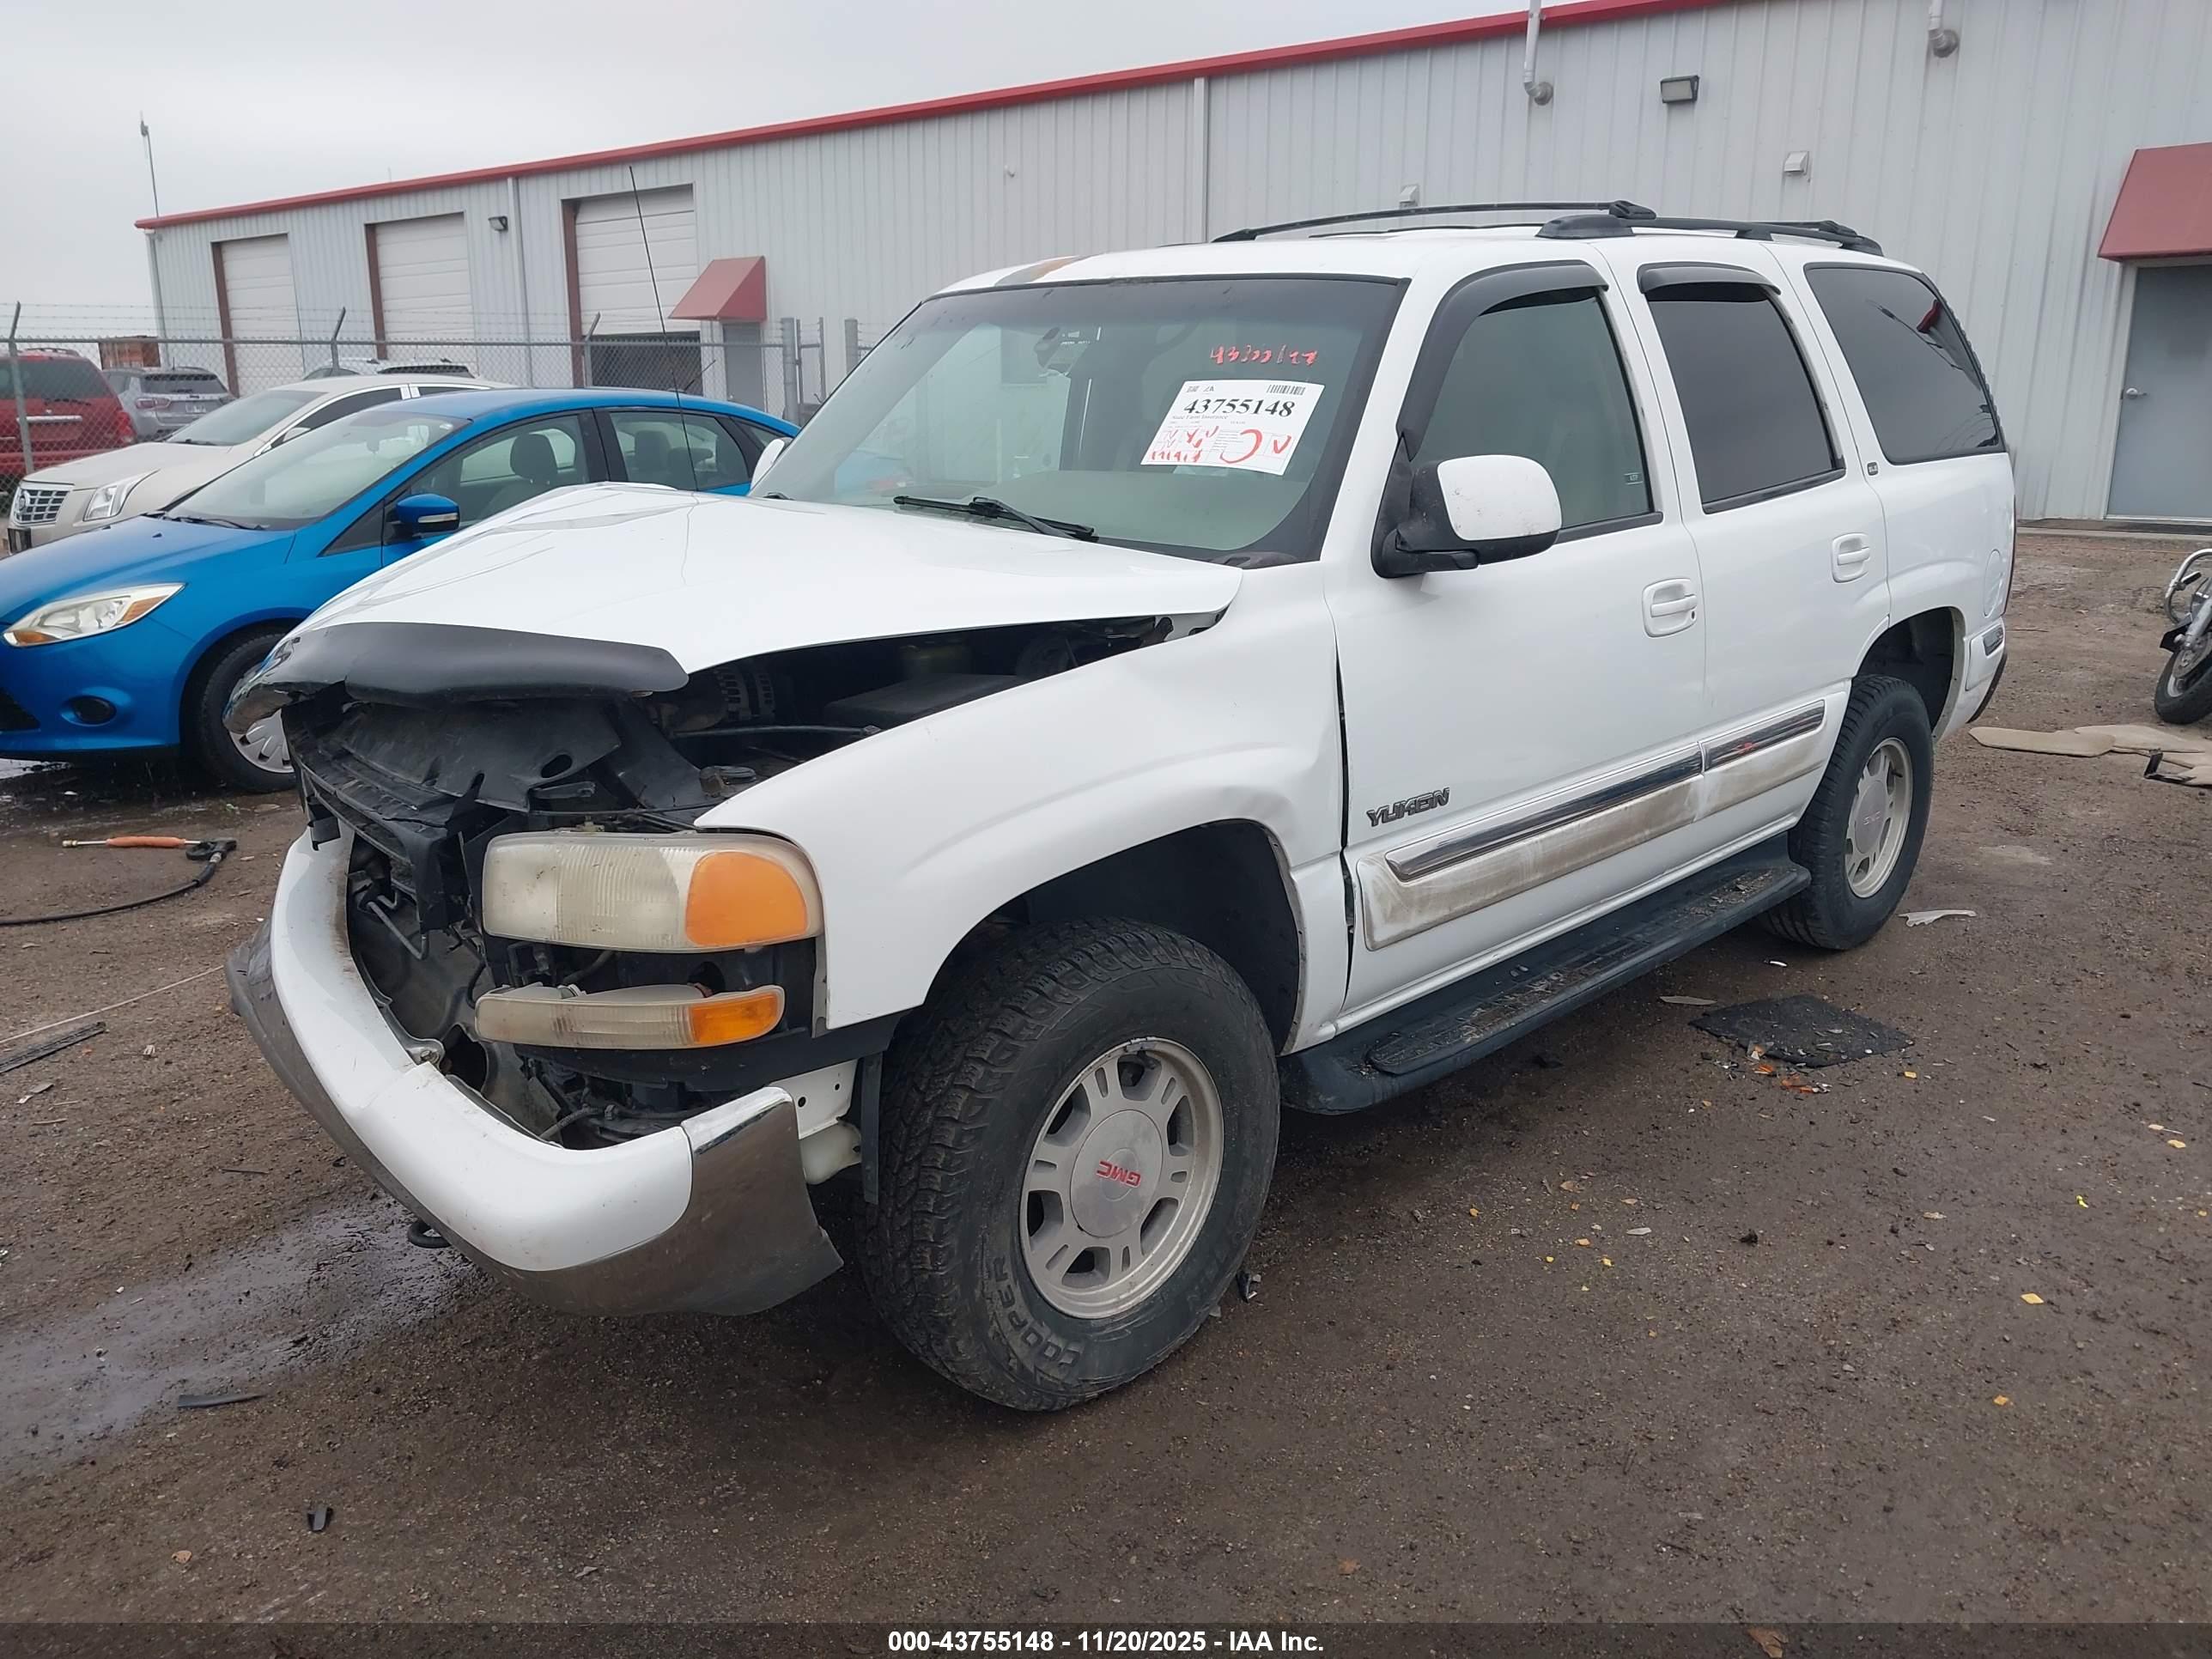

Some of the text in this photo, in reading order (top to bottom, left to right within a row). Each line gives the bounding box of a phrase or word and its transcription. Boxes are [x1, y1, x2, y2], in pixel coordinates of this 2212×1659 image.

[1183, 398, 1296, 417] 43755148
[1365, 787, 1449, 827] YUKON
[1097, 1160, 1141, 1188] GMC
[988, 1256, 1081, 1368] COOPER
